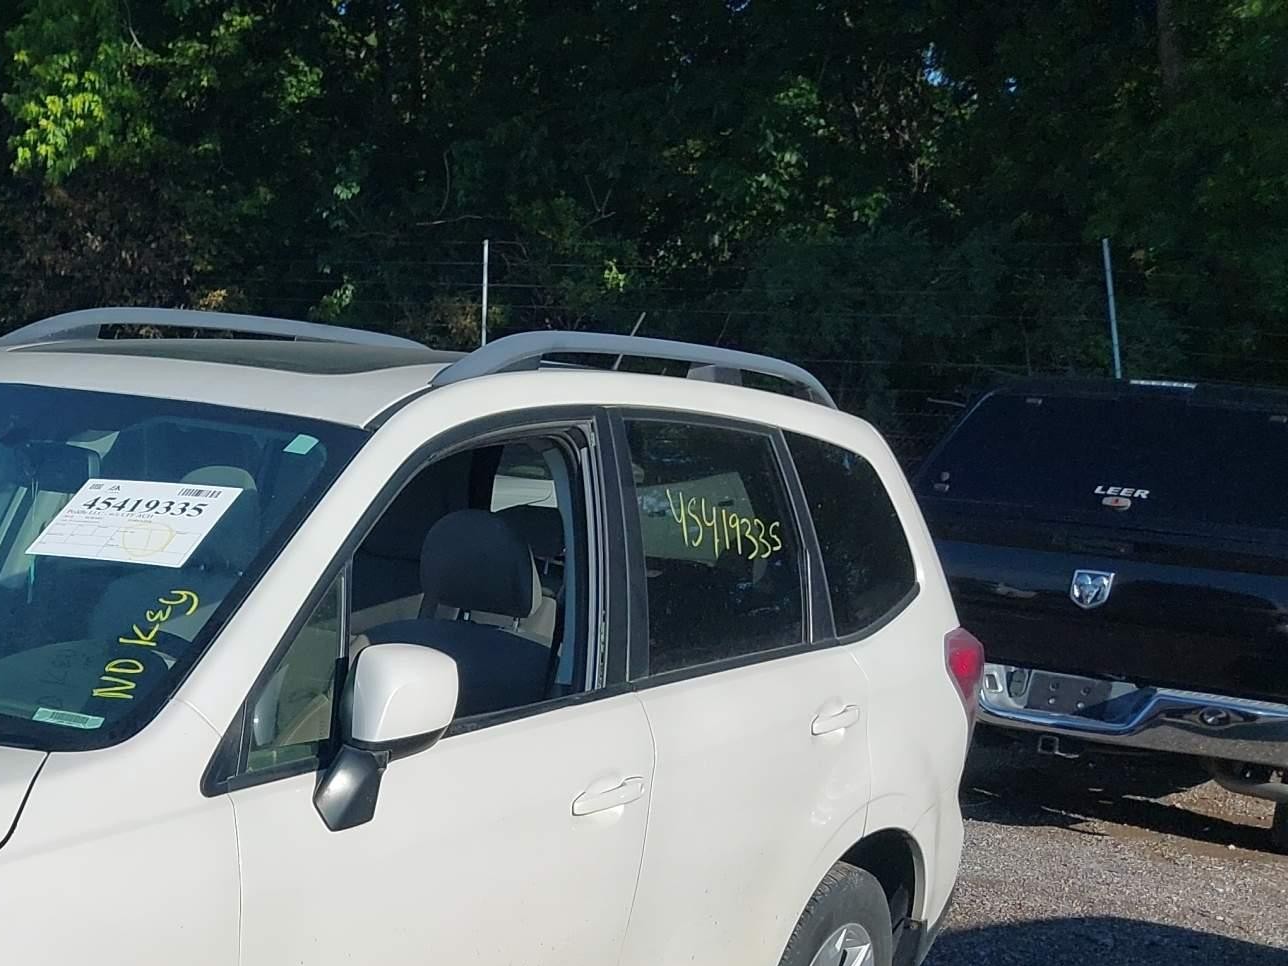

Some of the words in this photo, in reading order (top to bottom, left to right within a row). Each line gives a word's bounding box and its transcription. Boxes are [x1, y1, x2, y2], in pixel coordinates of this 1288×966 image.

[1094, 485, 1151, 499] LEER
[82, 496, 209, 518] 45419335
[666, 488, 782, 560] 45419335
